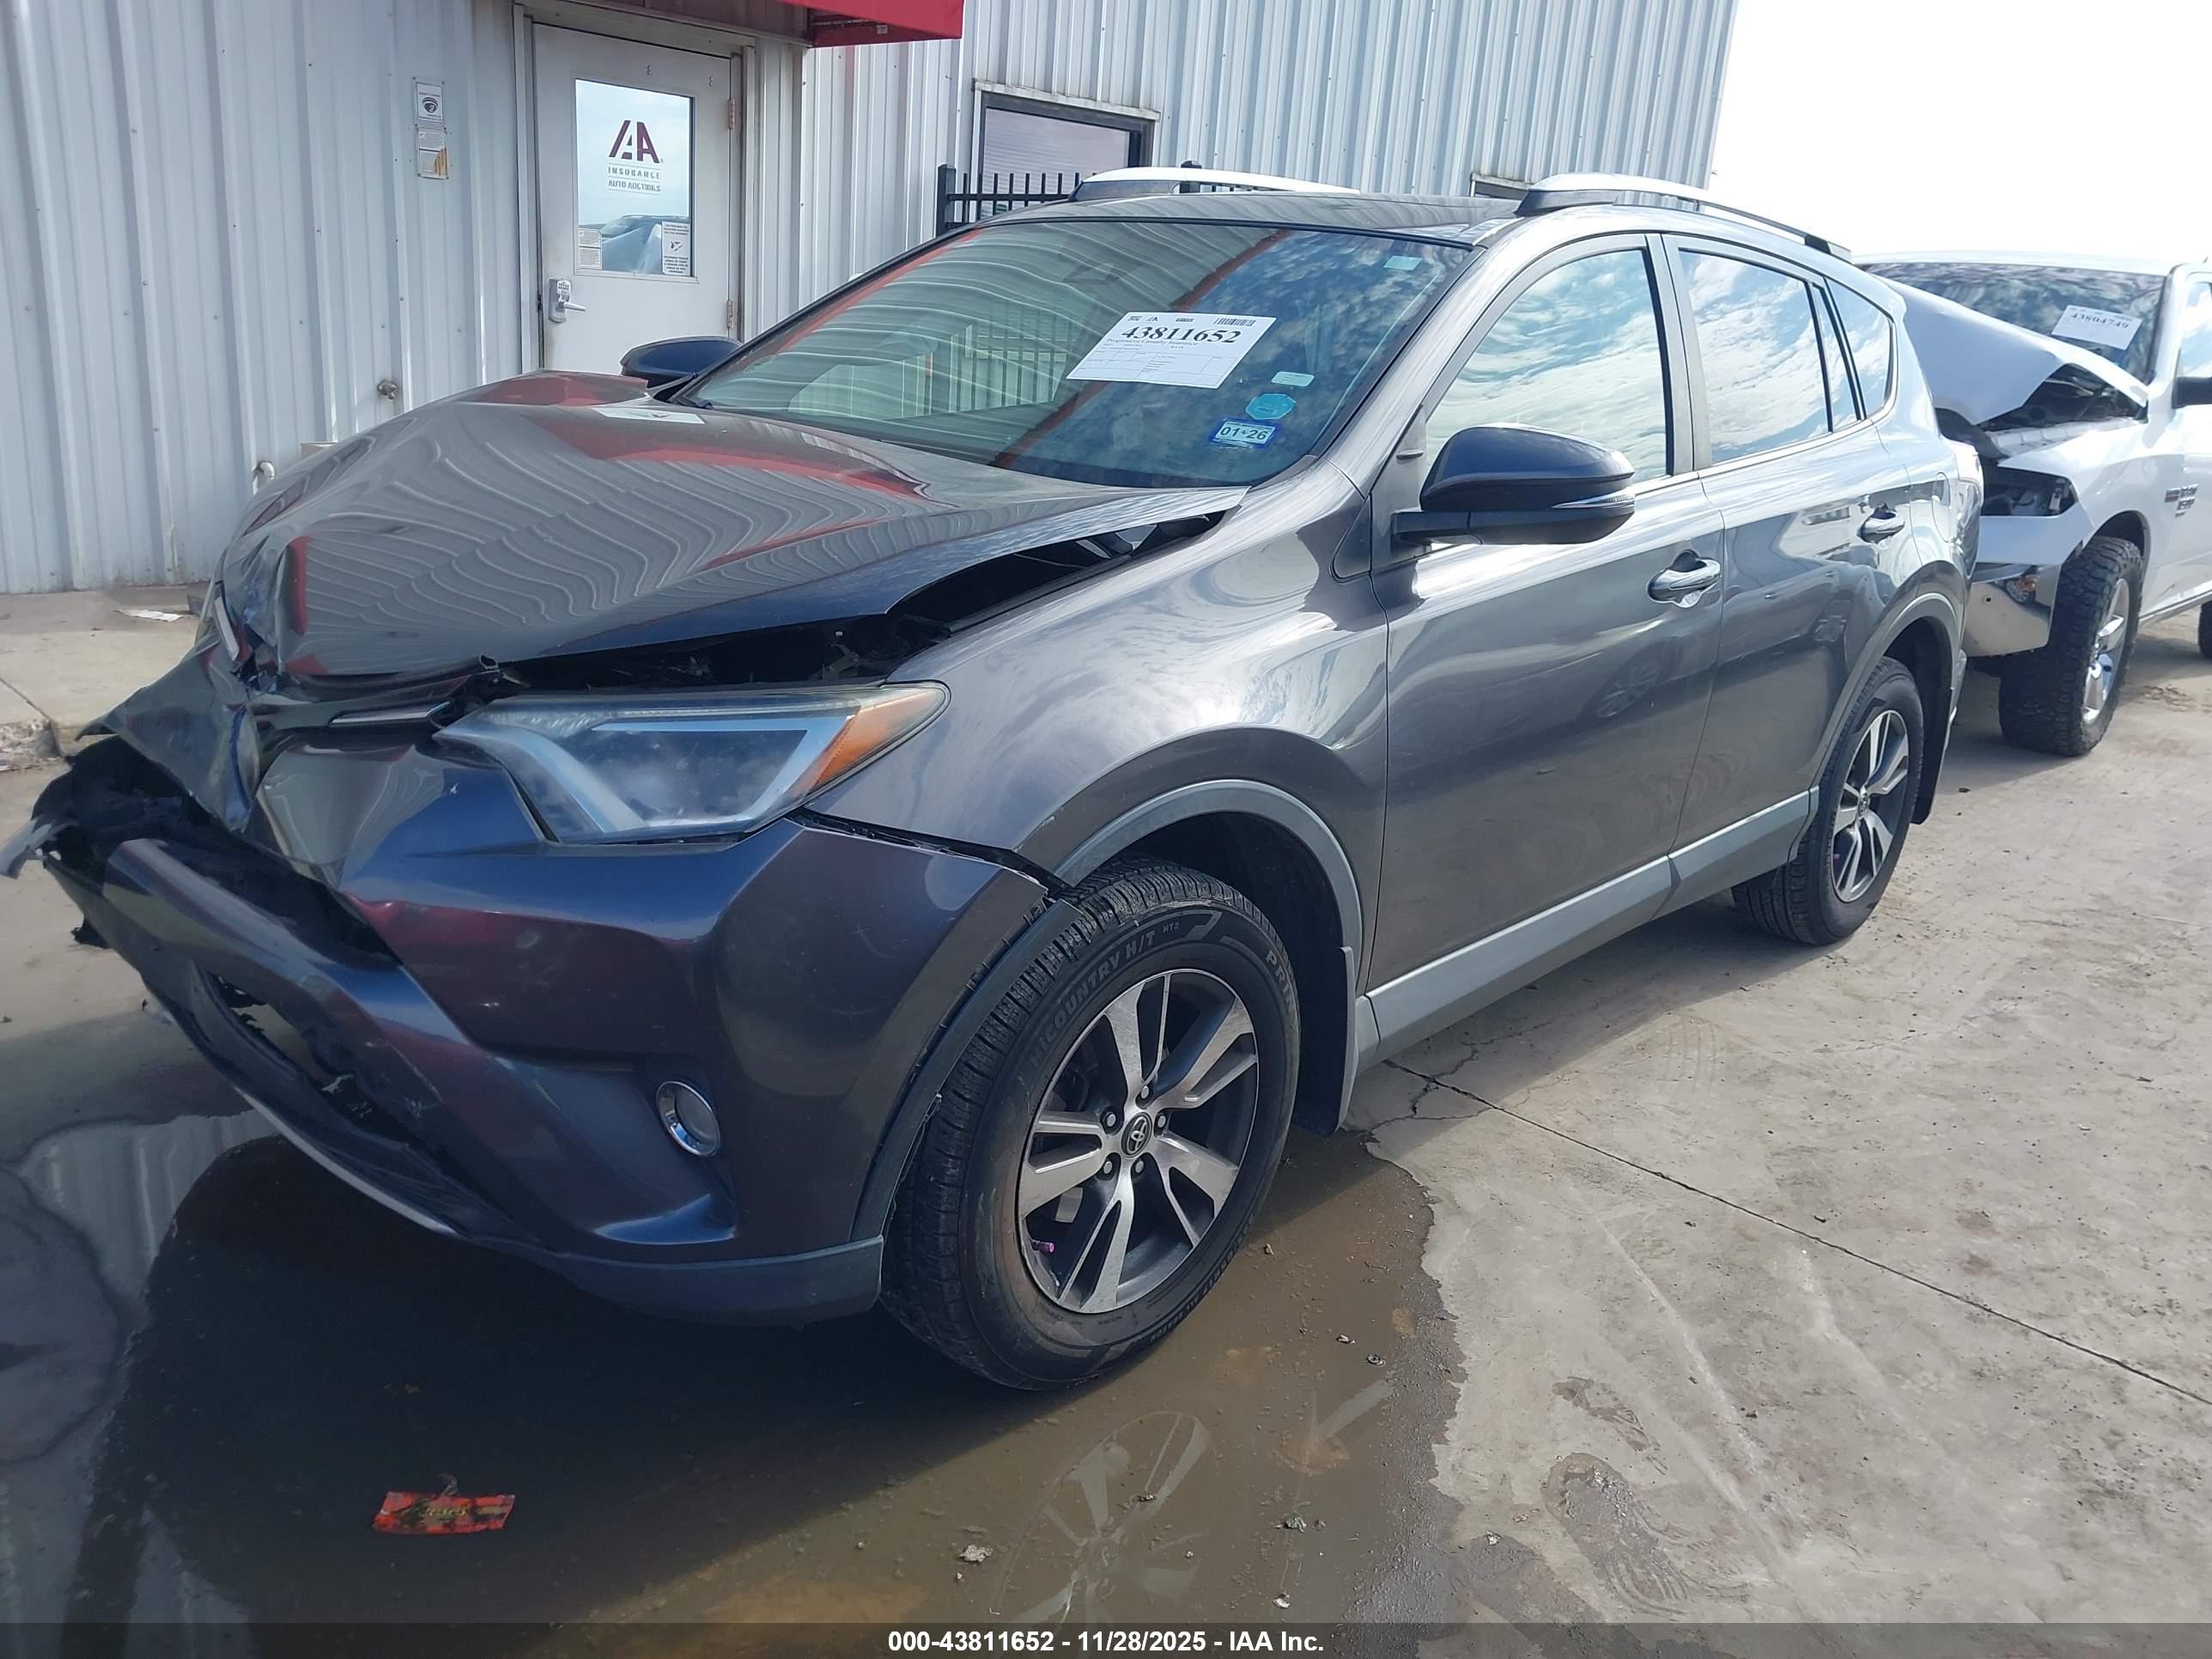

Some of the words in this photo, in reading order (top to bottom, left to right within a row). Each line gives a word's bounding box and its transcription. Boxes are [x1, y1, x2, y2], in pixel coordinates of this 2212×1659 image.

[608, 167, 660, 179] INSURANCE
[608, 179, 627, 188] AUTO
[628, 182, 661, 192] AUCTIONS
[1121, 325, 1243, 343] 43811652
